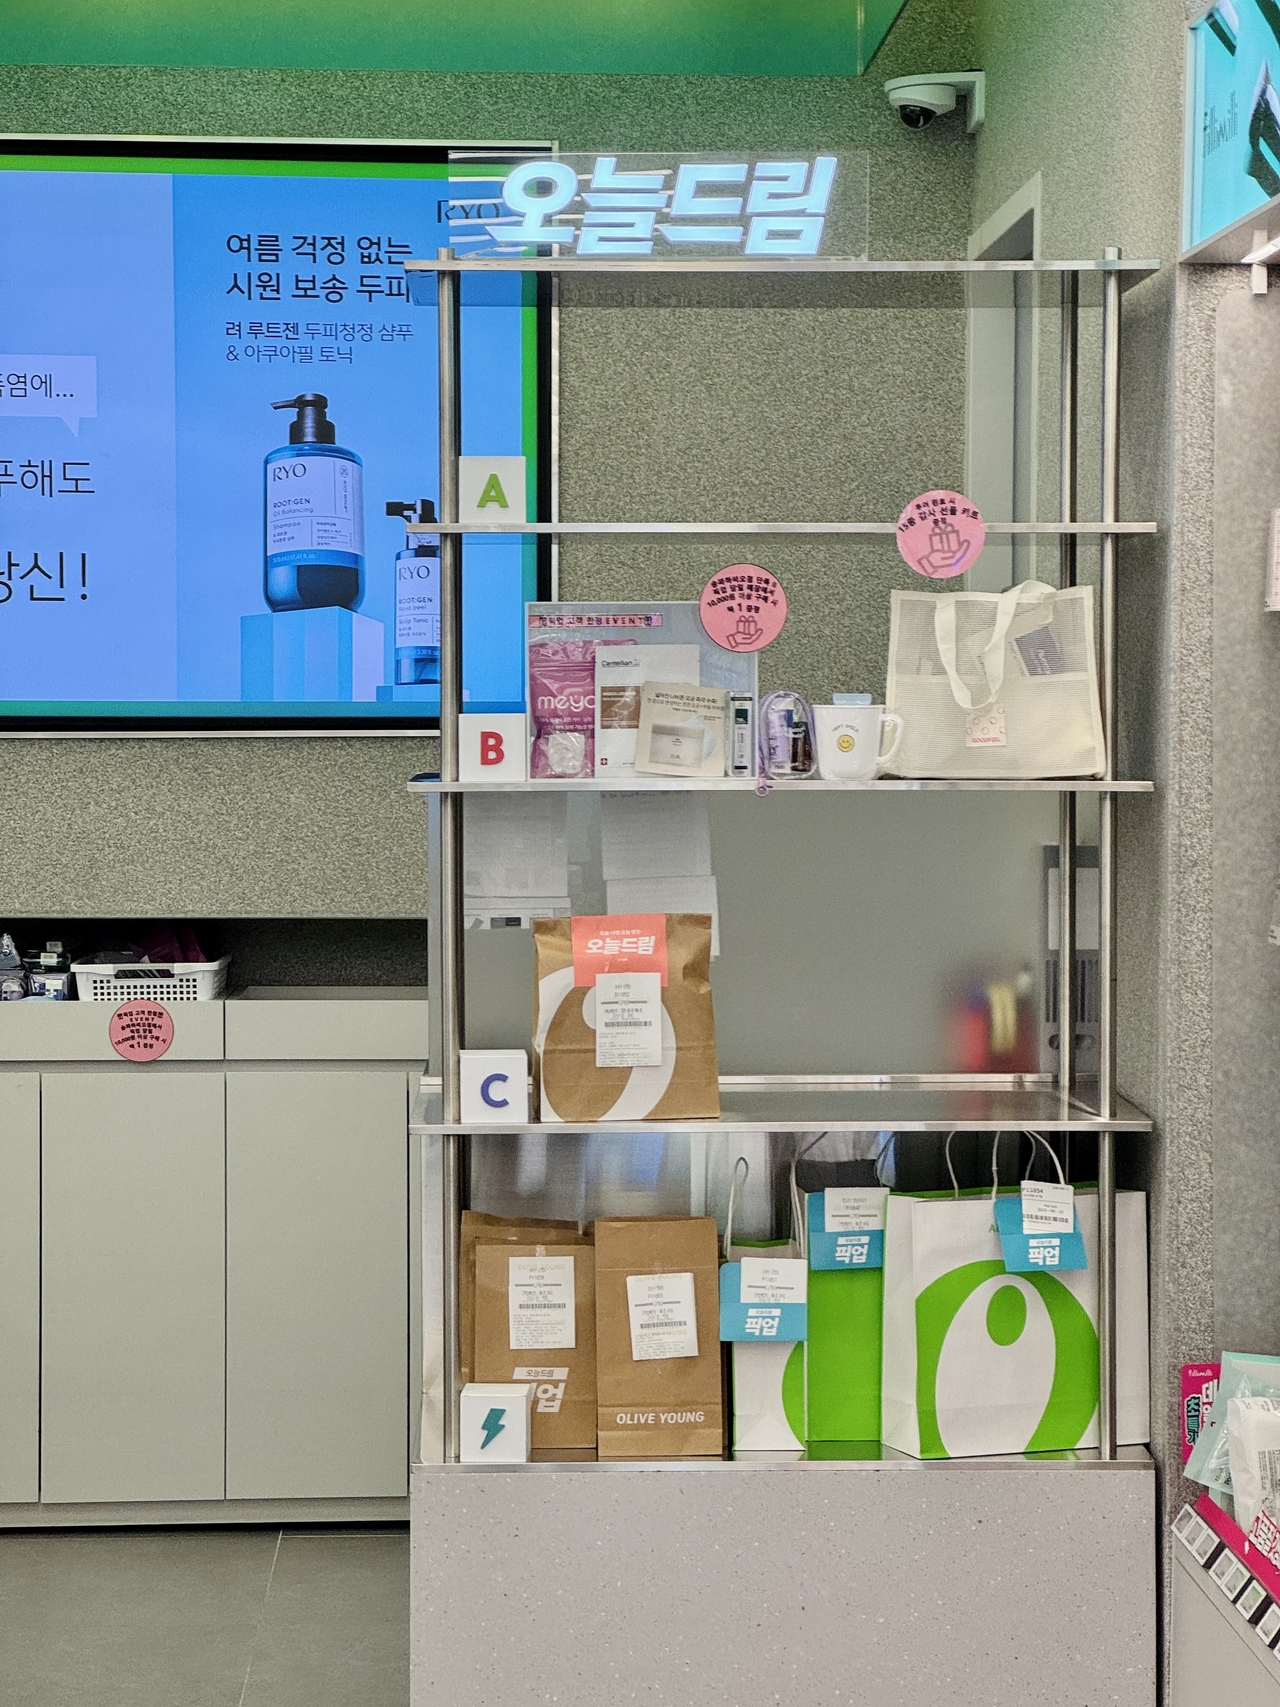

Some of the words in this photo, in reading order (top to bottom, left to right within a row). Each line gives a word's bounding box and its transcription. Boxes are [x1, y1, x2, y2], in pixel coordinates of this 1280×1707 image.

[485, 156, 837, 254] 오늘드림
[226, 234, 283, 263] 여름
[291, 235, 345, 265] 걱정
[357, 236, 413, 265] 없는
[226, 272, 281, 301] 시원
[291, 274, 348, 303] 보송
[356, 275, 411, 303] 두피
[226, 321, 242, 339] 려
[247, 321, 300, 341] 루트젠
[304, 322, 373, 342] 두피청정
[378, 323, 414, 342] 샴푸
[226, 345, 240, 362] &
[244, 345, 313, 363] 아쿠아필
[318, 346, 353, 364] 토닉
[0, 373, 74, 398] 염에...
[273, 463, 307, 482] RYO
[477, 472, 509, 509] A
[399, 565, 430, 581] RYO
[737, 602, 742, 612] 1
[480, 730, 504, 766] B
[585, 936, 656, 955] 오늘드림
[480, 1073, 510, 1109] C
[835, 1245, 869, 1263] 픽업
[1028, 1246, 1060, 1265] 픽업
[745, 1317, 780, 1336] 픽업
[526, 1369, 555, 1378] 오늘드림
[530, 1383, 566, 1413] 업
[616, 1413, 656, 1424] OLIVE
[659, 1412, 705, 1423] YOUNG
